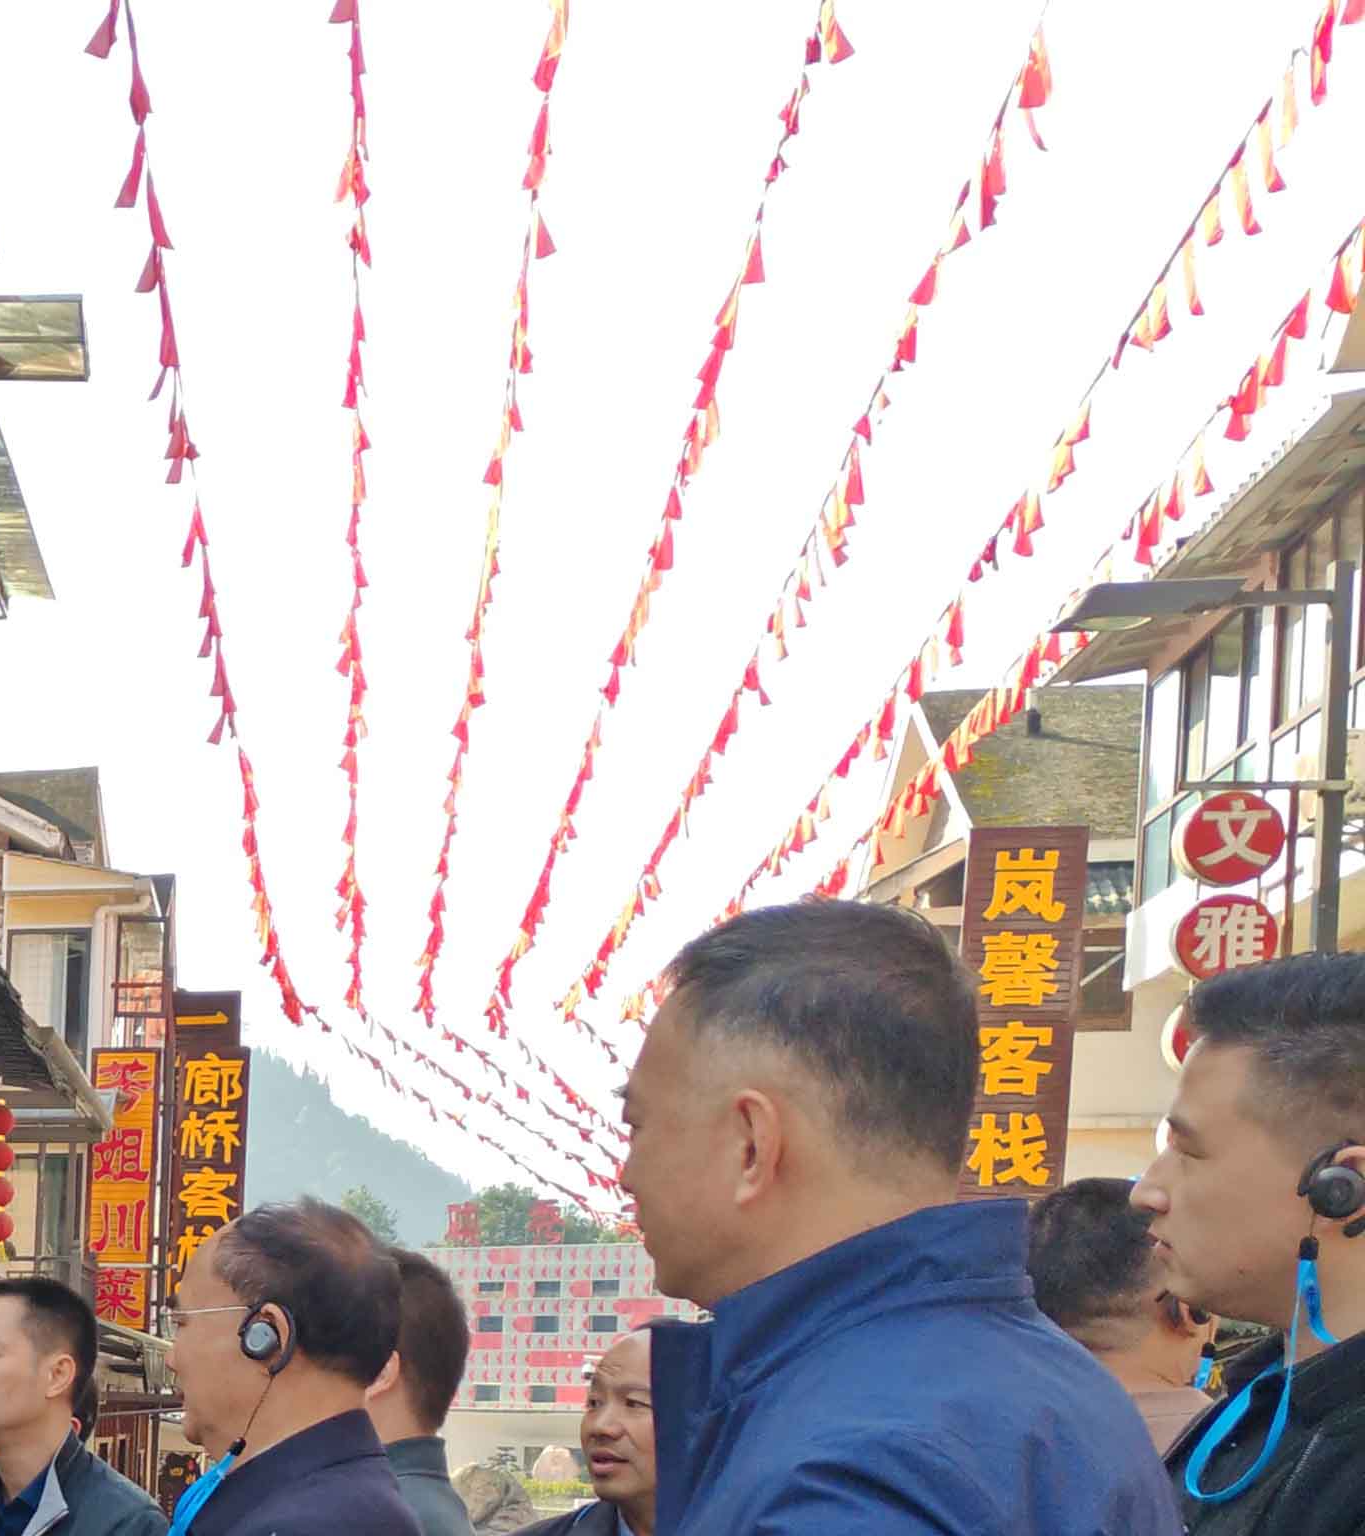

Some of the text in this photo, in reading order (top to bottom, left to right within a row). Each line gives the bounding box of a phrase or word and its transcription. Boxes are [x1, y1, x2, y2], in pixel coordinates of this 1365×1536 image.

[1193, 798, 1272, 971] 文雅
[967, 848, 1066, 1187] 岚馨客栈
